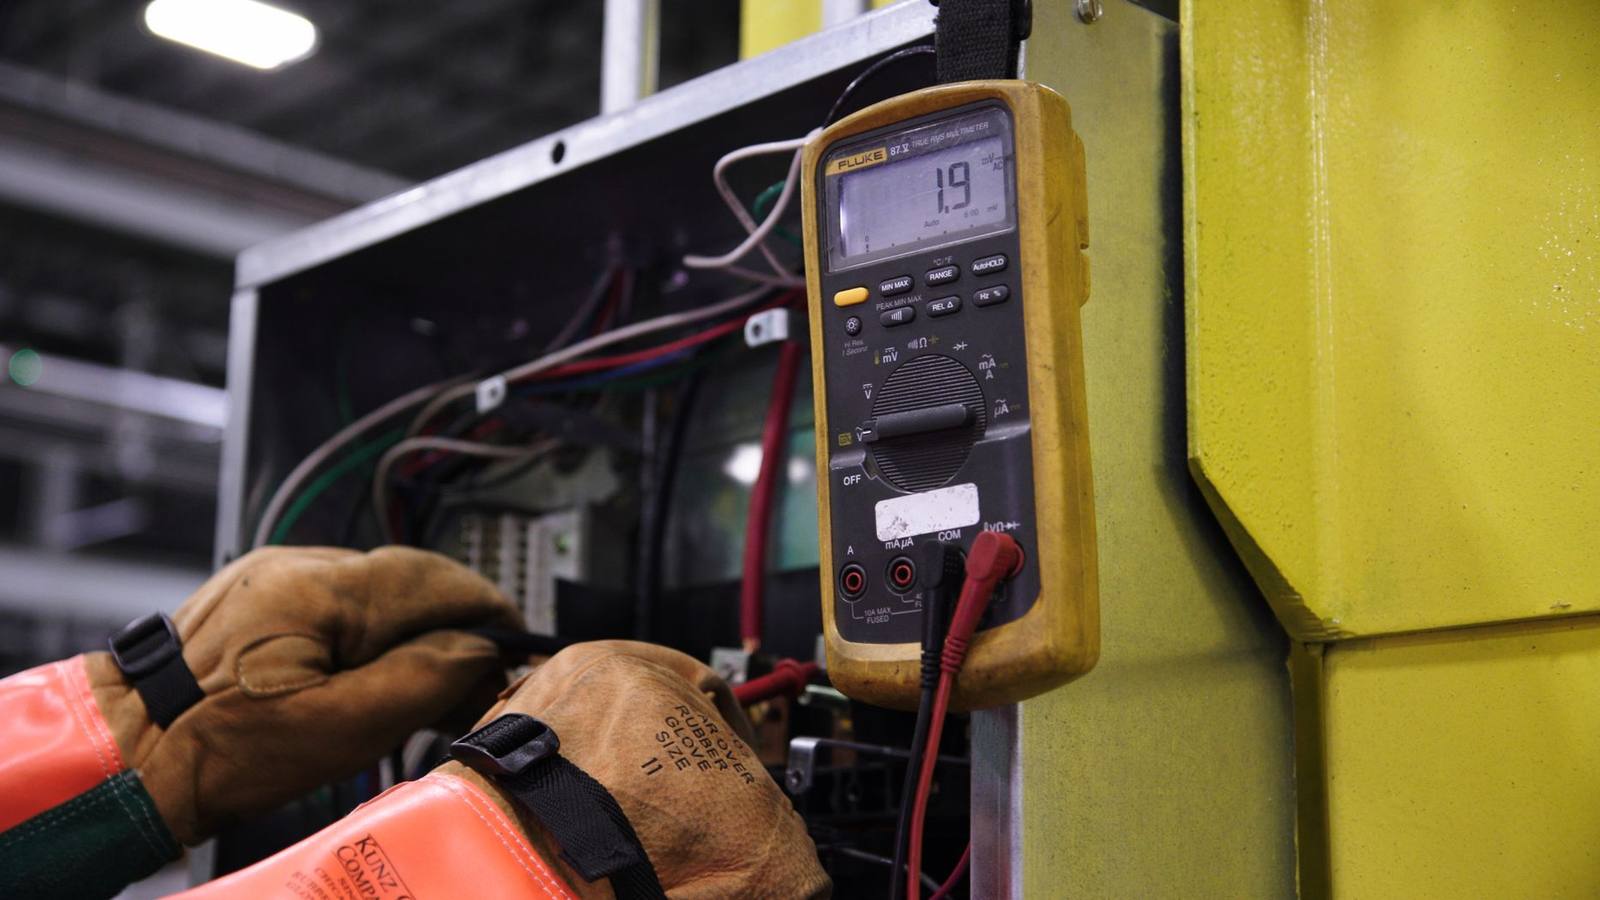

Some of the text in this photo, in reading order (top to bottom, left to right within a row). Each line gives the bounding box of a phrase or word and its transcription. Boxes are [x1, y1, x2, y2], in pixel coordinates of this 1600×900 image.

[838, 151, 884, 170] FLUKE
[936, 161, 971, 214] 1.9
[972, 257, 1005, 272] AutoHOLD
[929, 269, 953, 281] RANGE
[881, 278, 909, 291] MIN MAX
[875, 294, 922, 311] PEAK MIN MAX
[980, 292, 990, 300] Hz
[932, 302, 945, 311] REL
[882, 351, 898, 363] mV
[978, 357, 996, 371] mA
[985, 370, 994, 380] A
[863, 388, 872, 400] V
[843, 474, 861, 486] OFF
[937, 529, 961, 542] COM
[847, 546, 854, 555] A
[866, 615, 890, 624] FUSED
[664, 715, 713, 772] GLOVE
[674, 703, 729, 771] RUBBER
[655, 730, 692, 771] SIZE
[640, 756, 664, 776] 11
[716, 738, 755, 785] OVER
[354, 835, 398, 894] KUNZ
